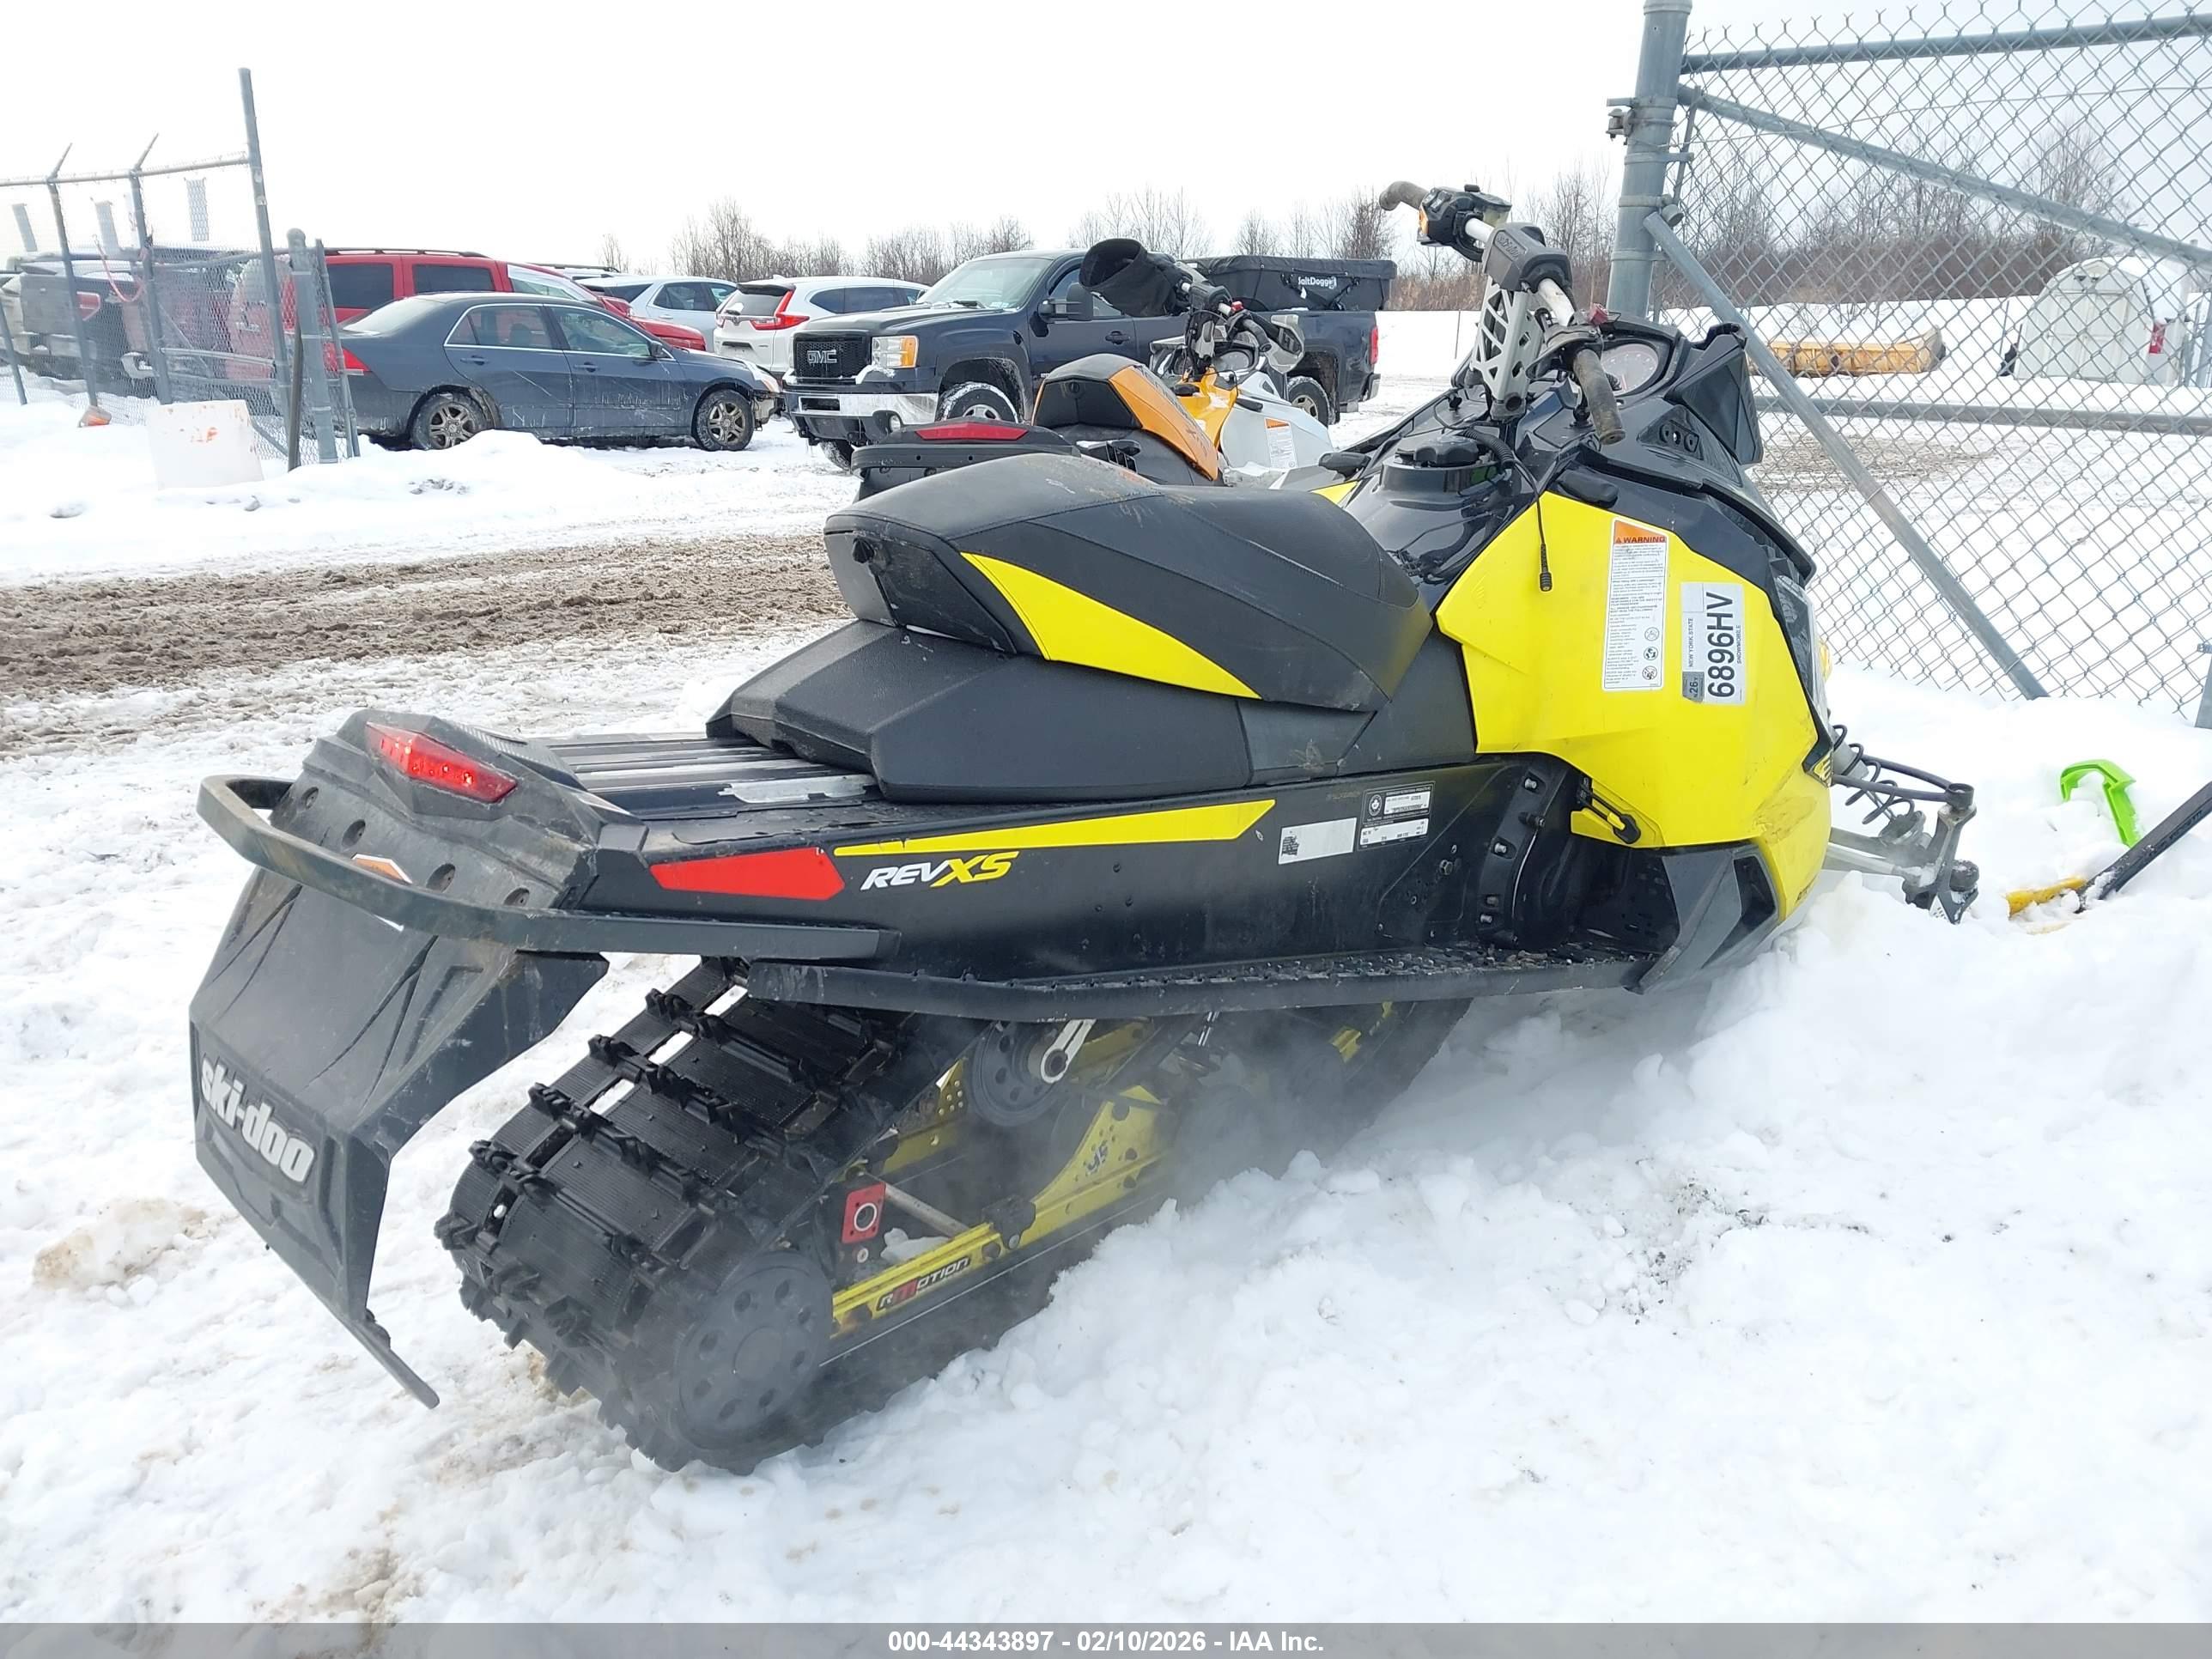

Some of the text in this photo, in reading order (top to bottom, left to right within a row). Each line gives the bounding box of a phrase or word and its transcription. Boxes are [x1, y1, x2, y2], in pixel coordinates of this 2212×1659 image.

[806, 349, 838, 364] GMC
[1705, 592, 1735, 698] 6896HV
[201, 1057, 315, 1183] ski-doo
